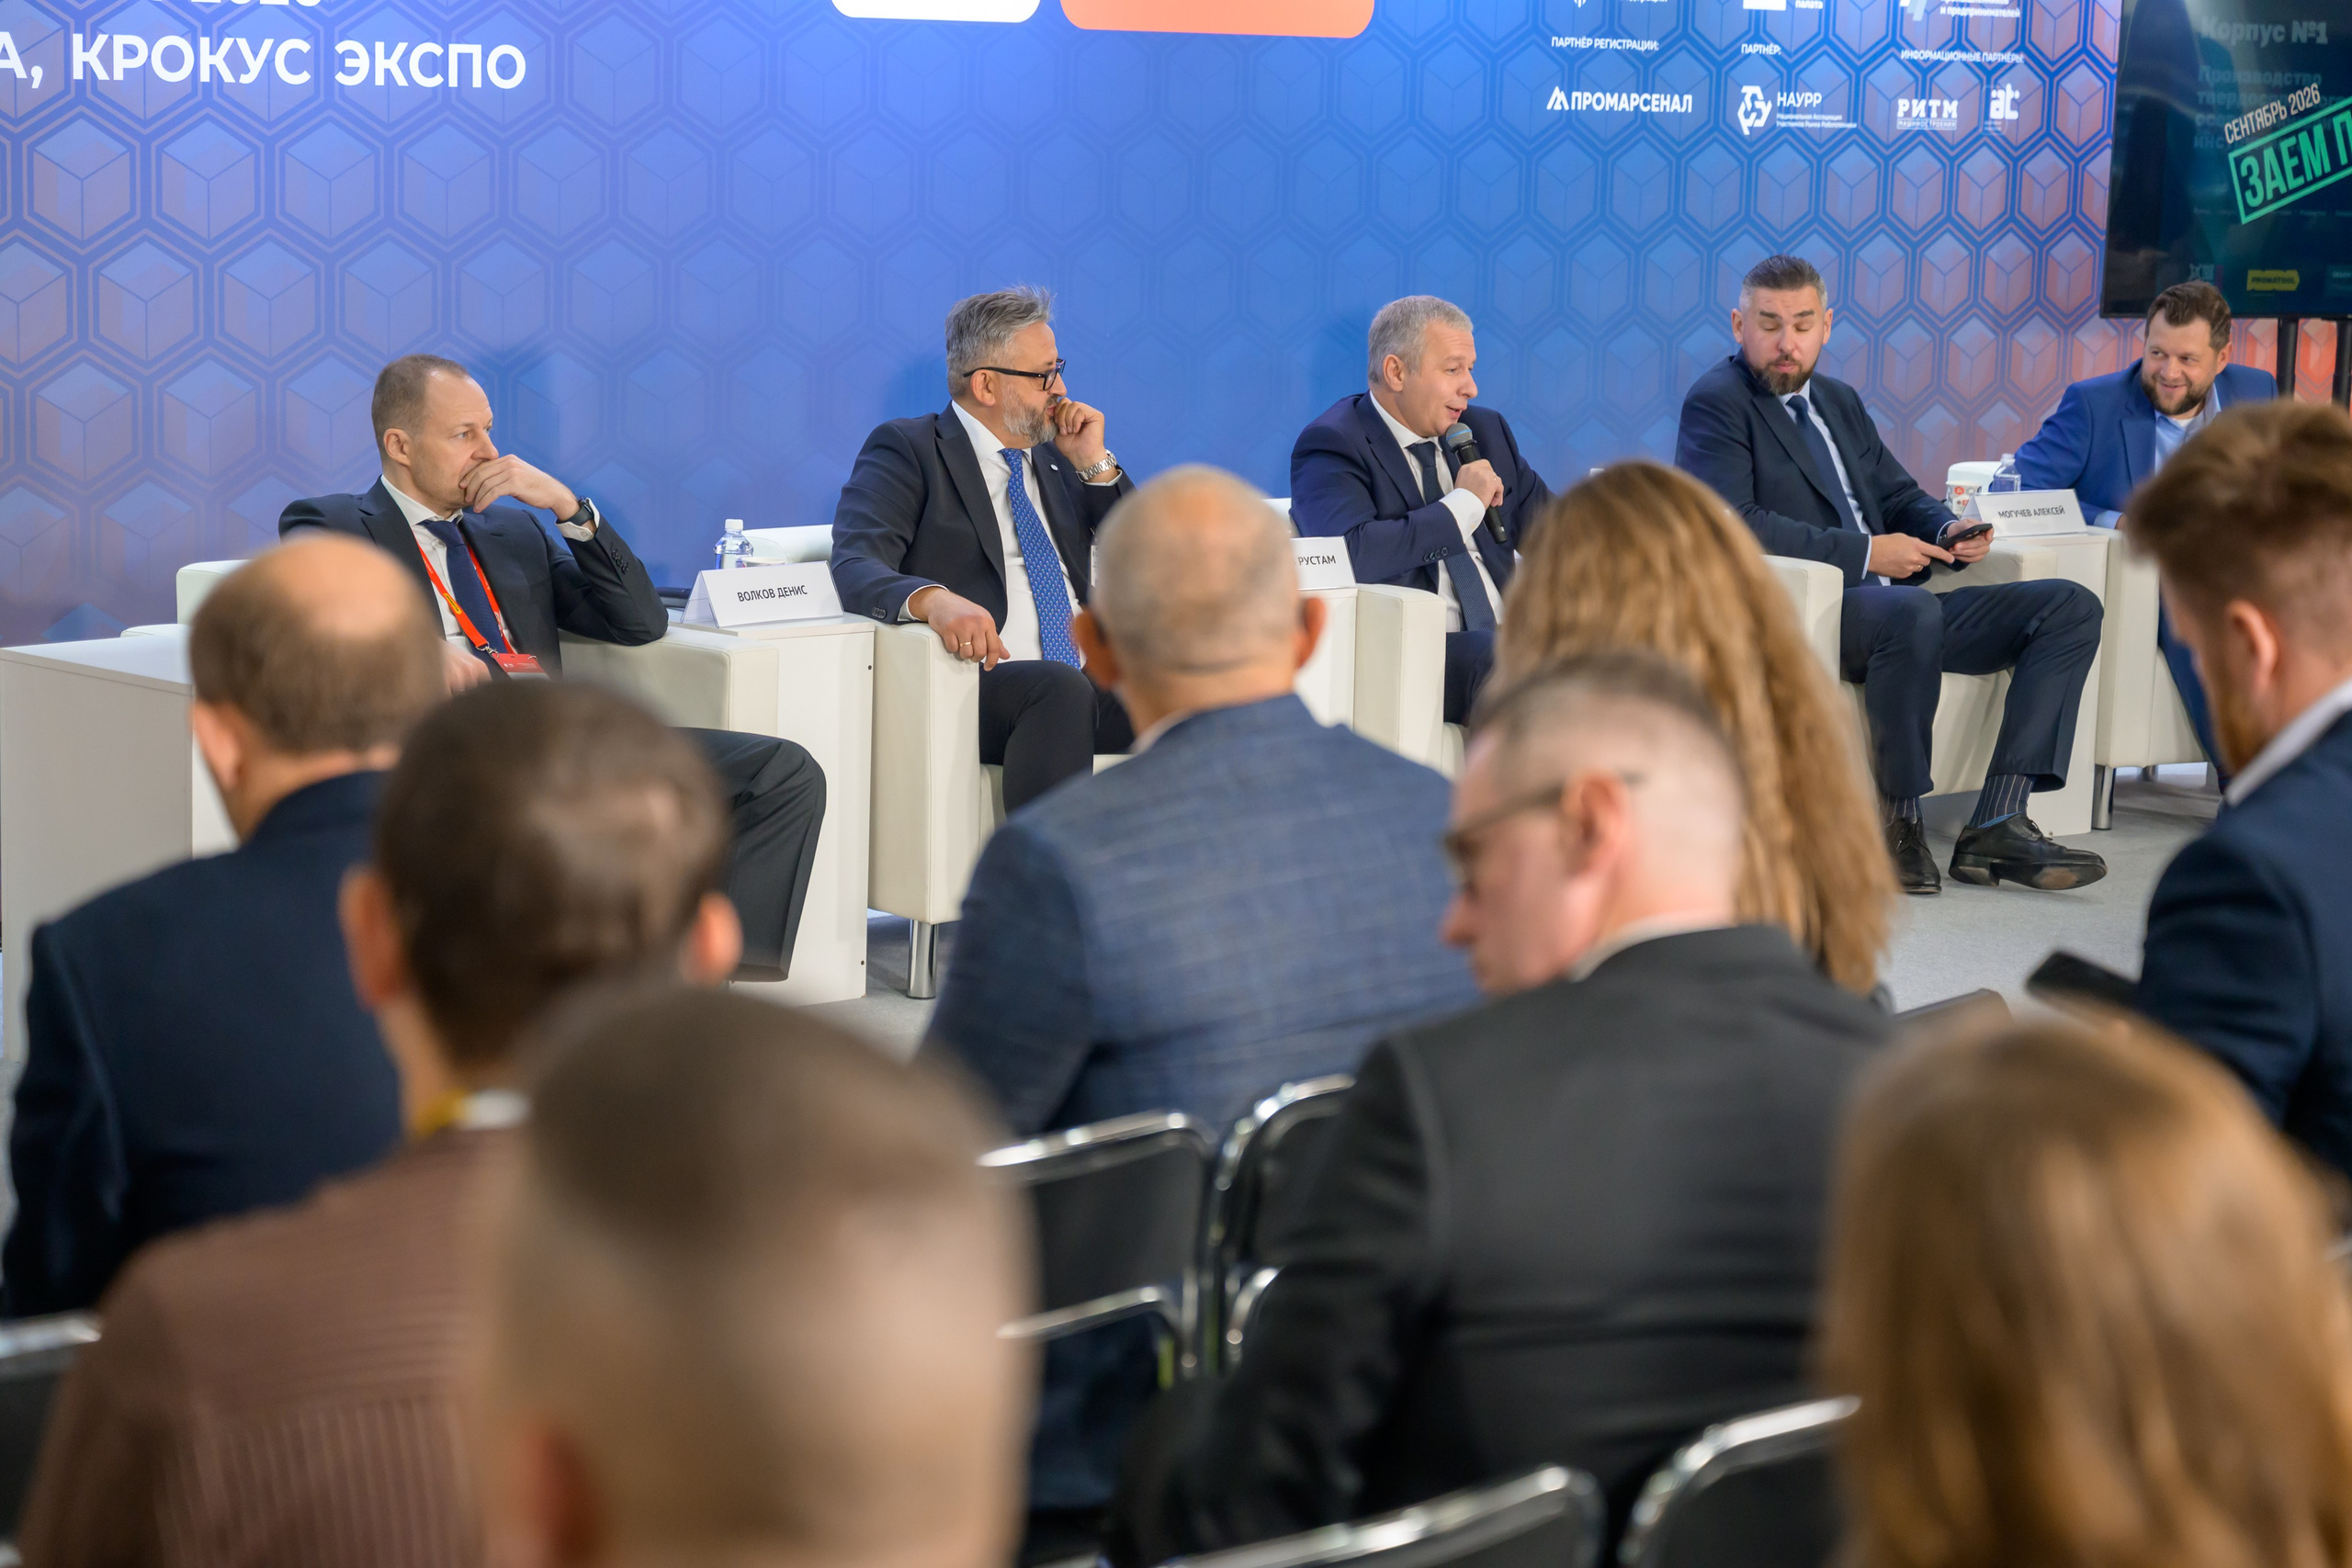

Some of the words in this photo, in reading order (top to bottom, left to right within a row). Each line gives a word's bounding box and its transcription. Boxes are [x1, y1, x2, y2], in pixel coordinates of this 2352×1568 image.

[1947, 7, 2020, 17] предпринимателей
[2201, 16, 2286, 48] Корпус
[1551, 36, 1593, 49] ПАРТНЁР
[1594, 38, 1659, 51] РЕГИСТРАЦИИ:
[1741, 42, 1781, 55] ПАРТНЁР:
[0, 31, 43, 89] А,
[73, 33, 311, 85] КРОКУС
[334, 39, 526, 90] ЭКСПО
[1901, 49, 1982, 62] ИНФОРМАЦИОННЫЕ
[1982, 51, 2025, 63] ПАРТНЁРЫ:
[1570, 91, 1692, 113] ПРОМАРСЕНАЛ
[1777, 91, 1823, 108] НАУРР
[1896, 98, 1959, 118] РИТМ
[2223, 99, 2288, 144] СЕНТЯБРЬ
[2288, 82, 2321, 116] 2026
[2240, 122, 2332, 208] ЗАЕМ
[1997, 509, 2032, 519] МОГУЧЕВ
[2033, 505, 2065, 517] АЛЕКСЕЙ
[1297, 555, 1337, 566] РУСТАМ
[737, 587, 775, 603] ВОЛКОВ
[777, 584, 808, 599] ДЕНИС
